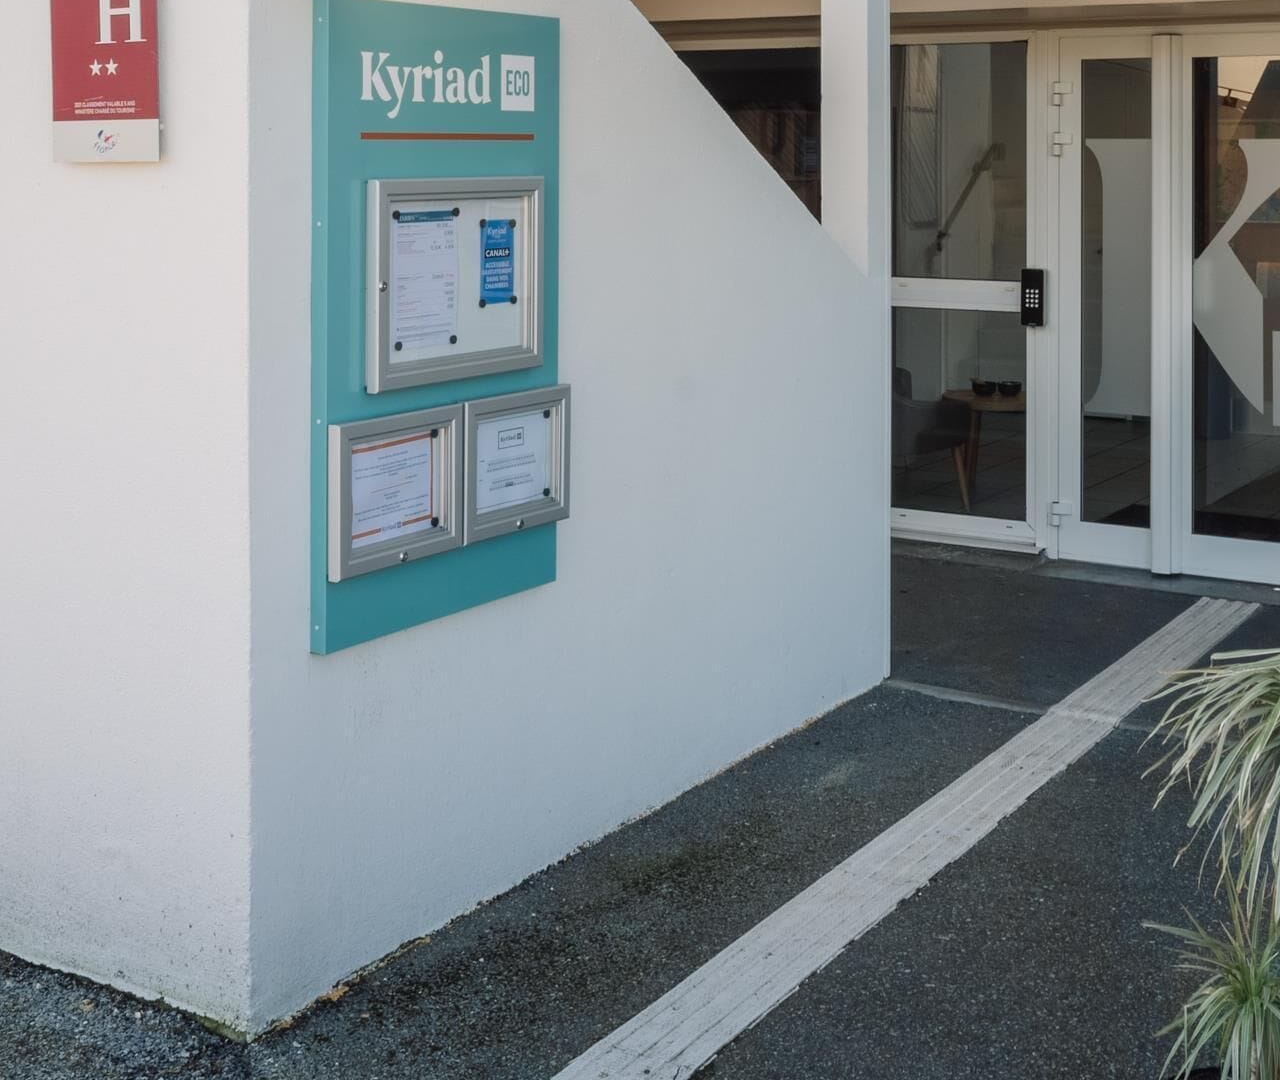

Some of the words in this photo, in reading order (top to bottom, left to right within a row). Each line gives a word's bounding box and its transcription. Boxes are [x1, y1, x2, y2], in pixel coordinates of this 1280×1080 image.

[360, 50, 492, 119] Kyriad
[506, 70, 530, 96] ECO
[485, 249, 510, 258] CANAL+
